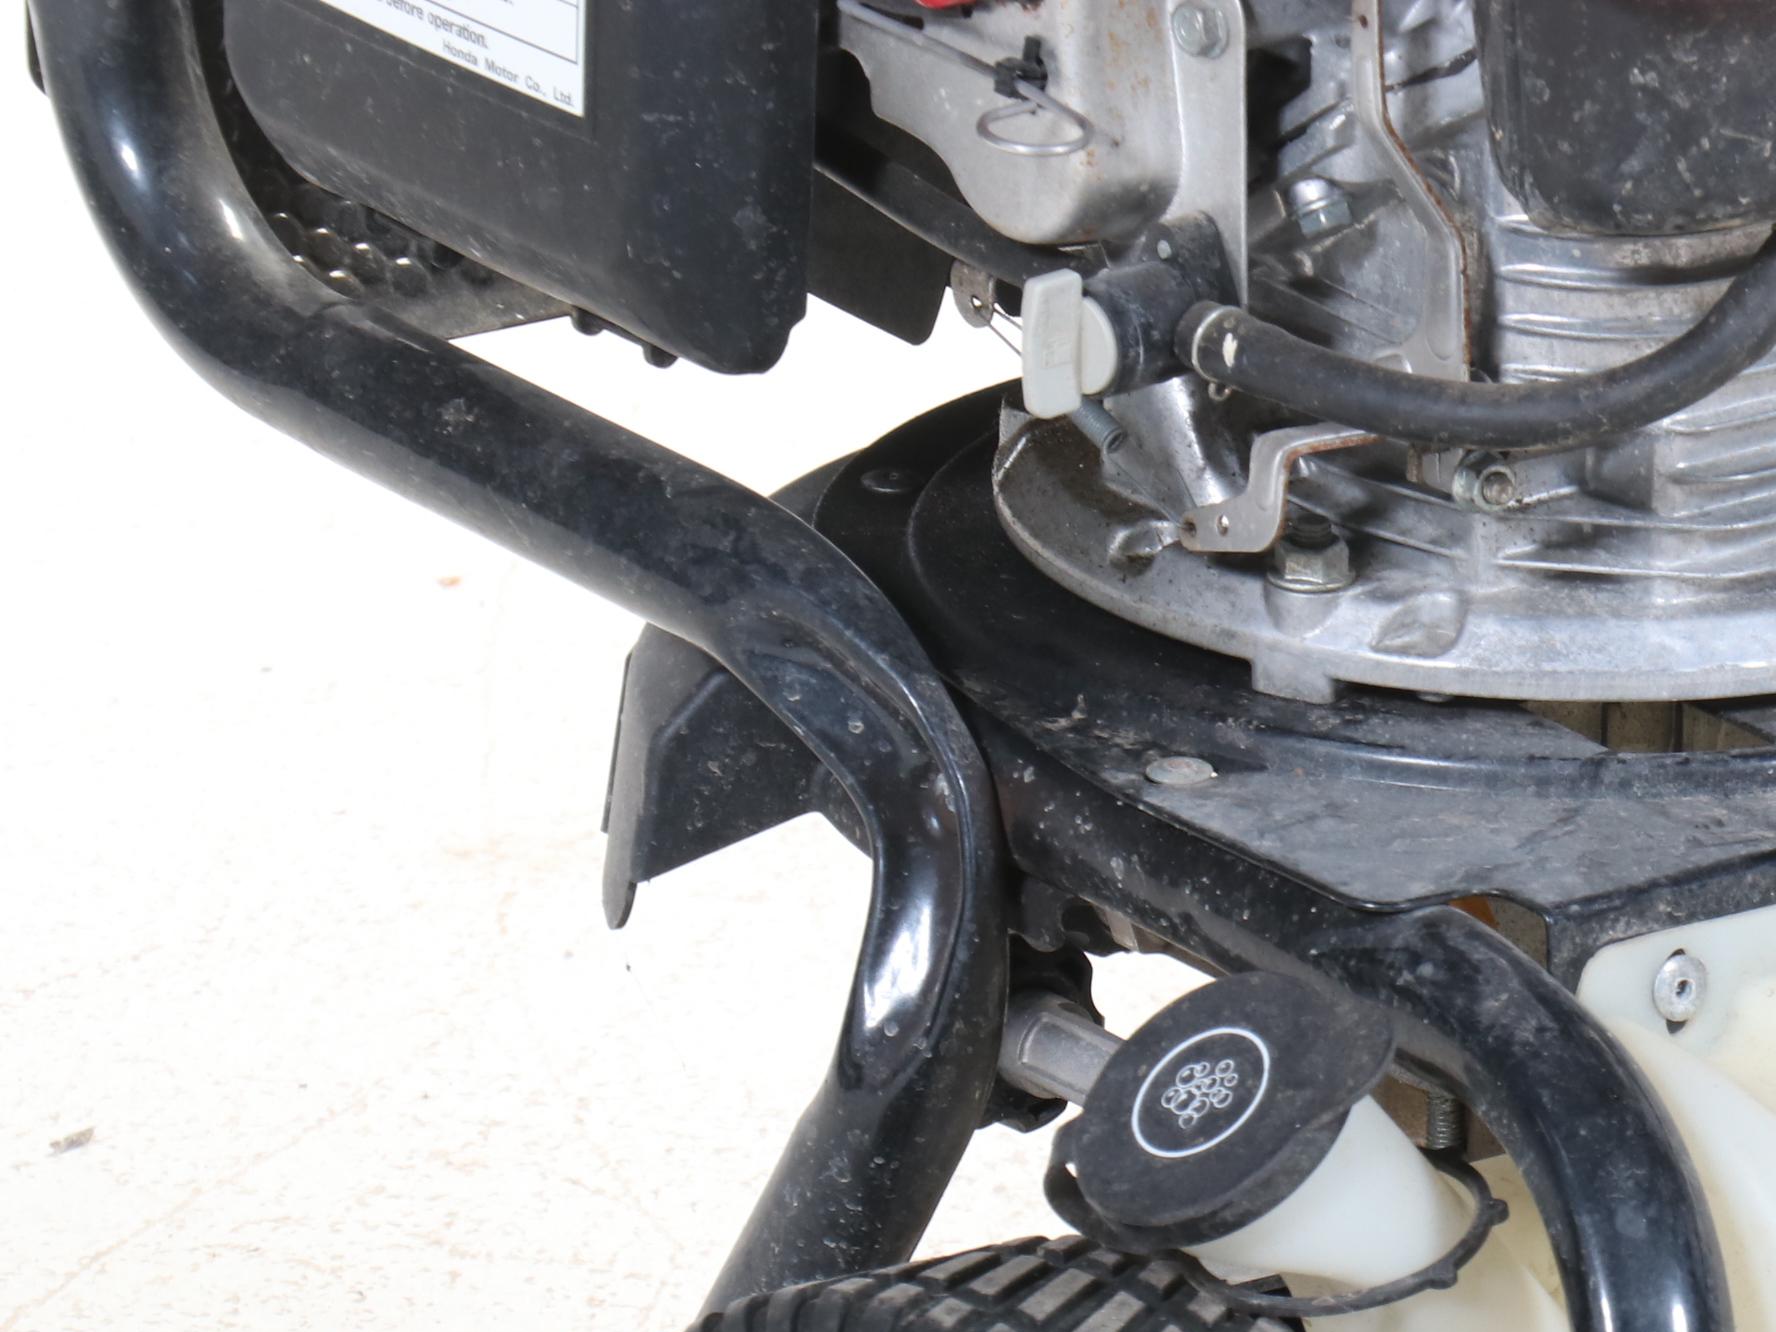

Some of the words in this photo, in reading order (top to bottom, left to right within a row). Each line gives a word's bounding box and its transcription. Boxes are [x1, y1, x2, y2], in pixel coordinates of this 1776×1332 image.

[428, 12, 489, 48] operation.
[442, 39, 479, 66] Honda
[484, 57, 519, 83] Motor
[552, 86, 574, 107] Ltd.
